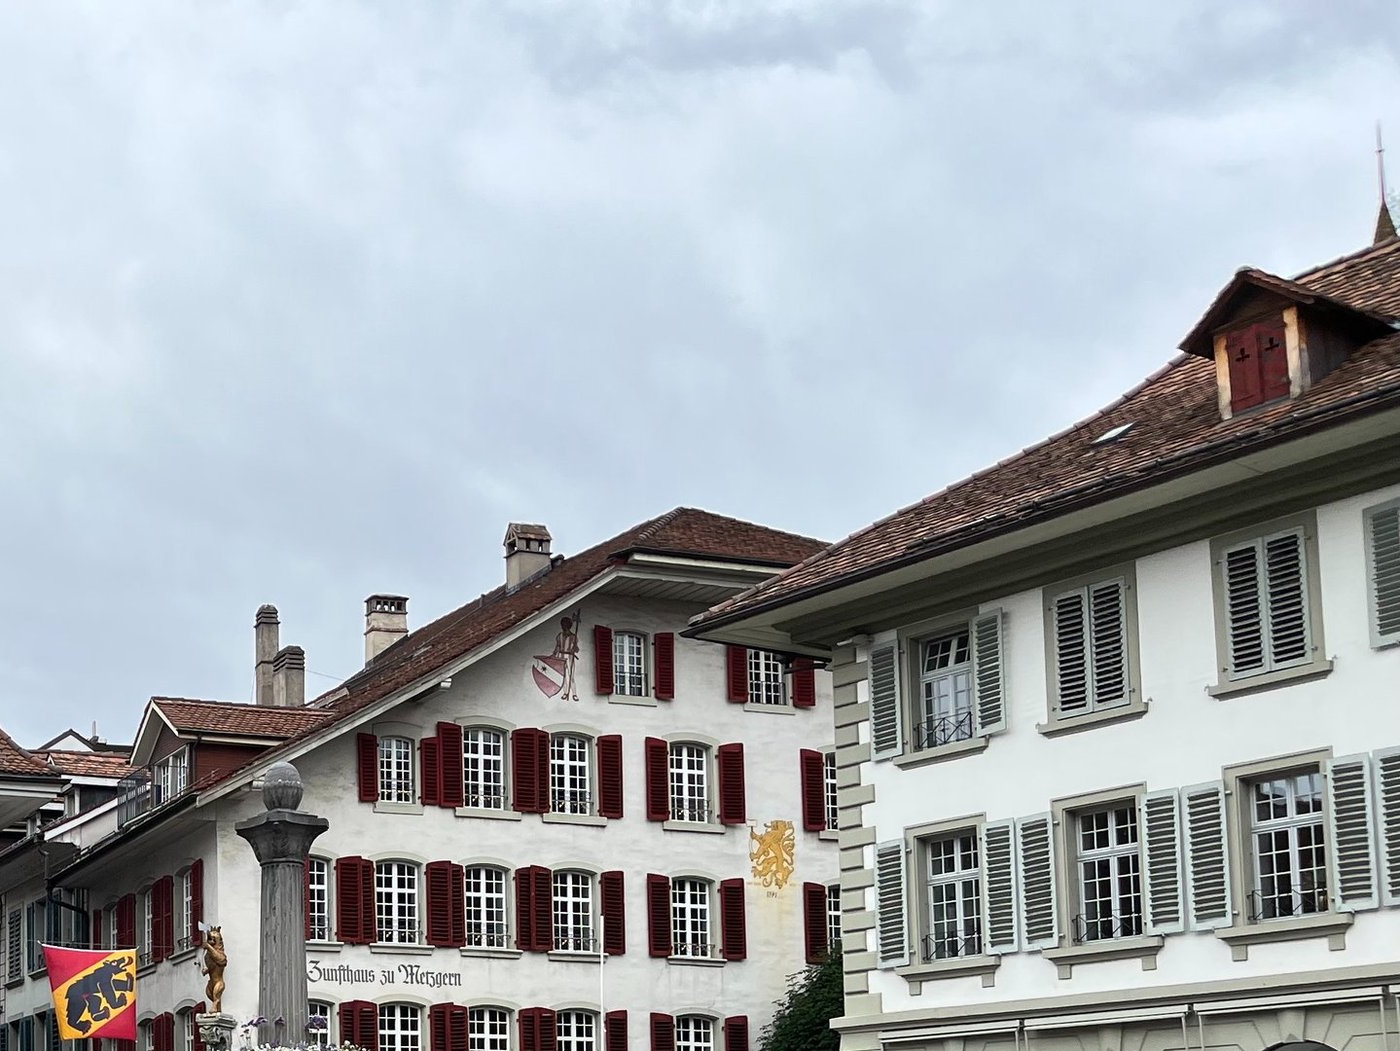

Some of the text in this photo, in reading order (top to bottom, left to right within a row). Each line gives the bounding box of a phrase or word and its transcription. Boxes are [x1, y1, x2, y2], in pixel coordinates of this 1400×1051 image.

[306, 960, 462, 988] Zunfthaus zu Metzgern
